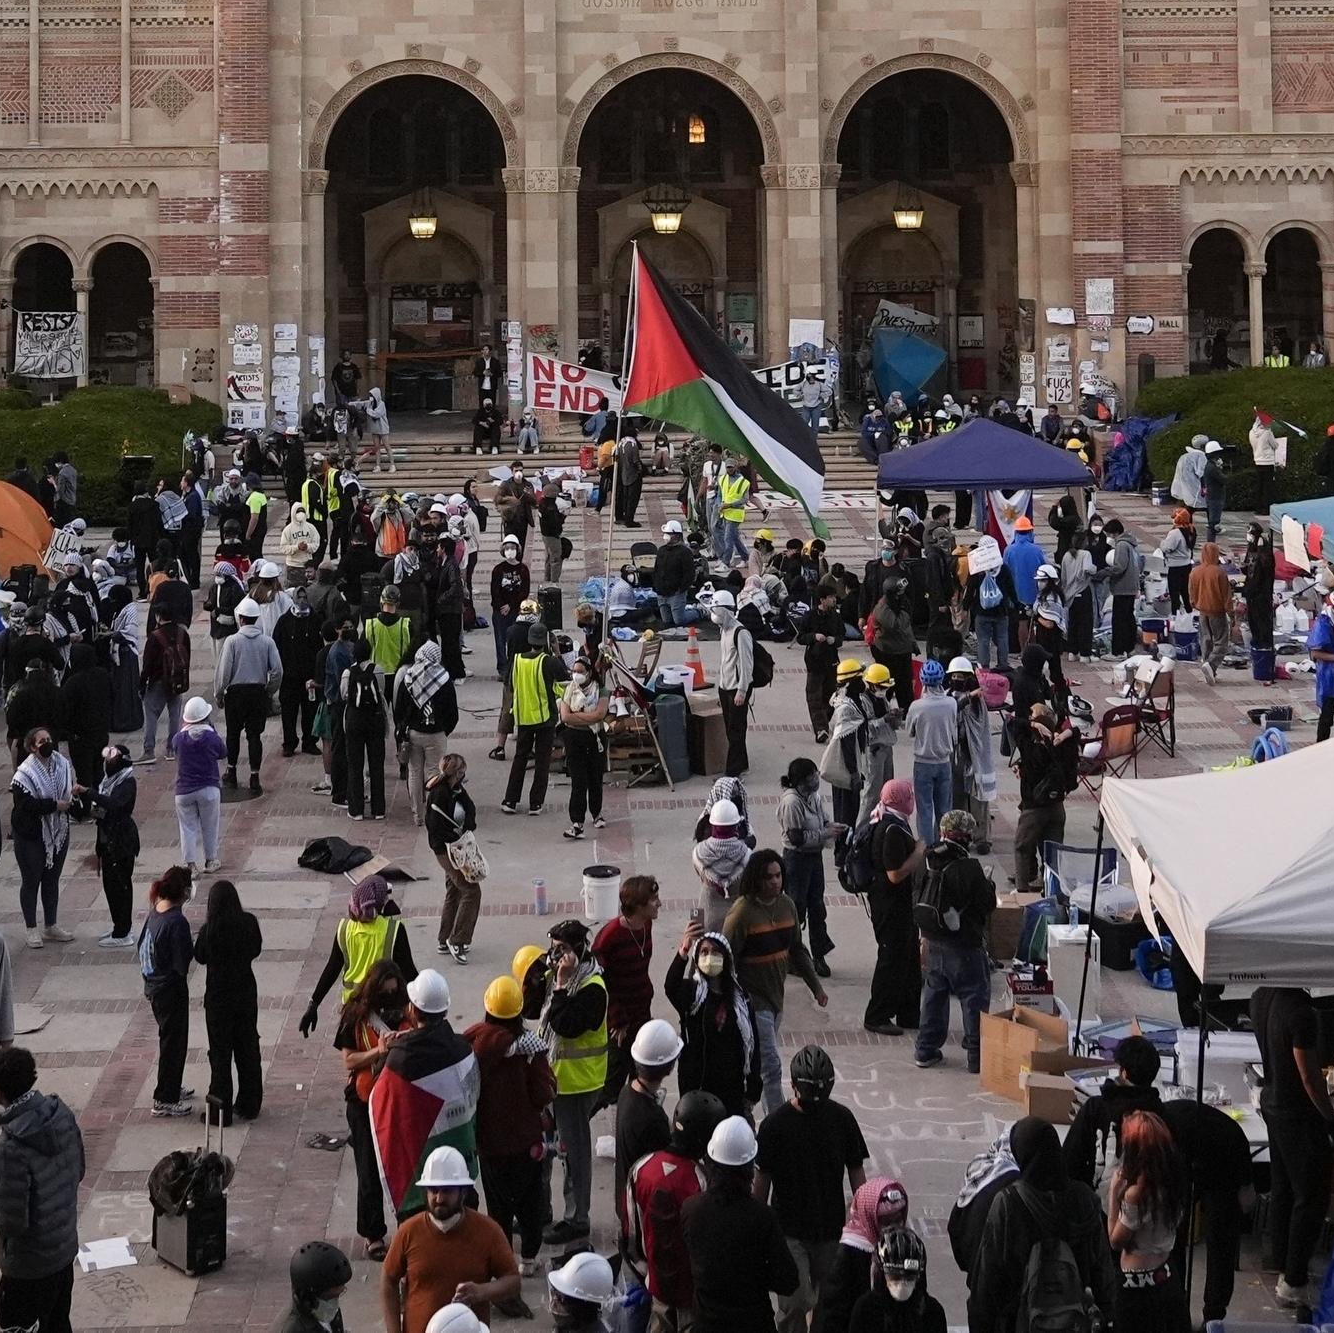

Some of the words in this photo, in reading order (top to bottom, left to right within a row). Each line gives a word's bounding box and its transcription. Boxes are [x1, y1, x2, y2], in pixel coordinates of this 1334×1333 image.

[21, 312, 77, 332] RESIST
[1158, 320, 1180, 328] HALL
[533, 355, 587, 382] NO
[235, 373, 260, 381] ARTISTS
[1047, 378, 1072, 389] FUCK
[534, 383, 605, 411] END
[1053, 389, 1064, 402] 12
[292, 530, 311, 540] UCLA
